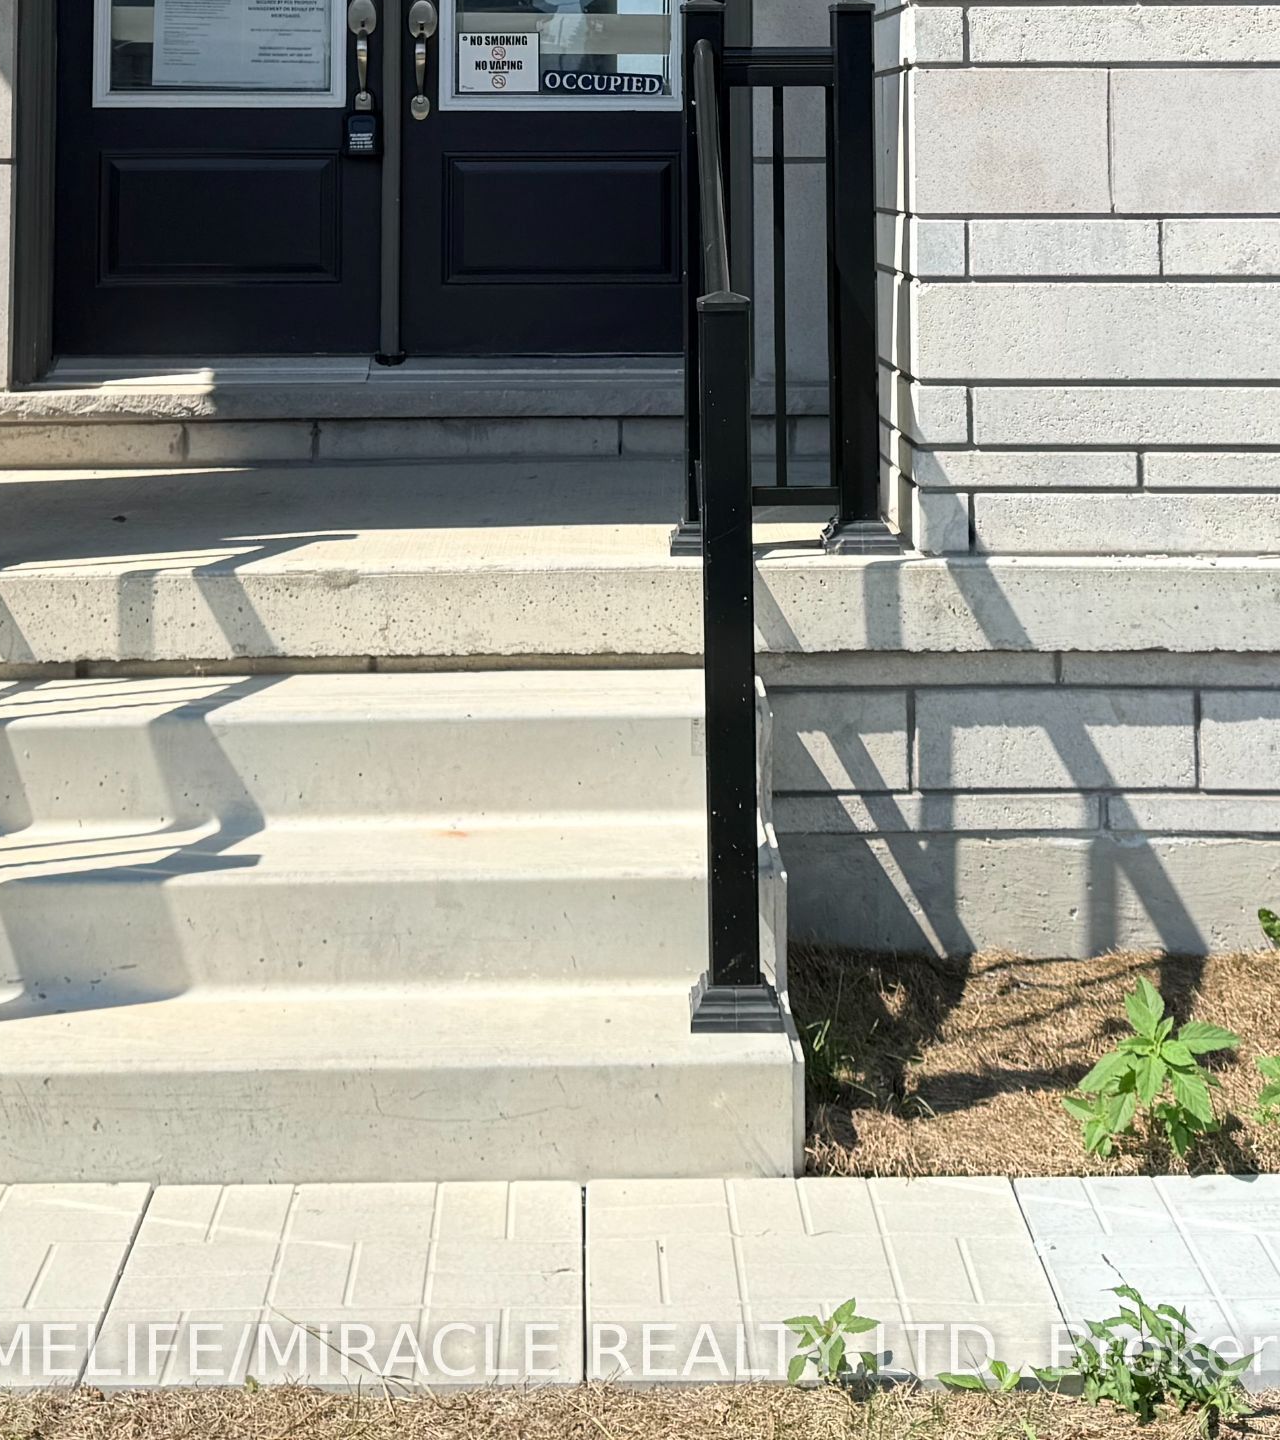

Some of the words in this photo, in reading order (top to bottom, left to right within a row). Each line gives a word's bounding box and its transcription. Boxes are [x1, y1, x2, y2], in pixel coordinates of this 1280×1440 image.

[470, 35, 483, 46] NO
[484, 35, 528, 46] SMOKING
[475, 60, 487, 71] NO
[489, 60, 523, 71] VAPING
[545, 72, 660, 93] OCCUPIED
